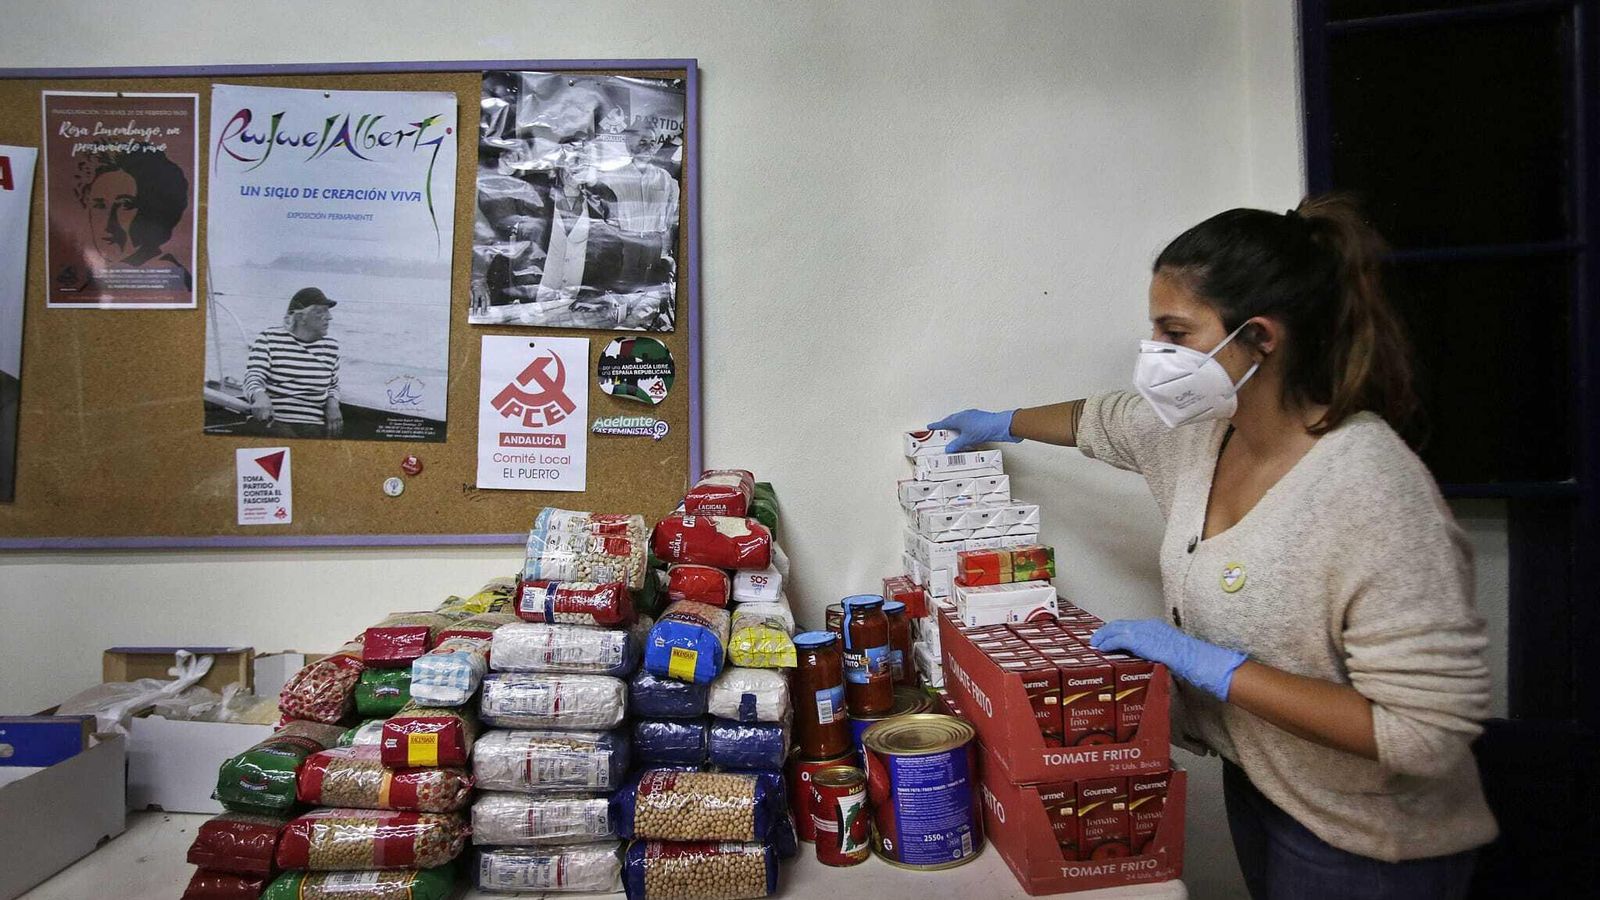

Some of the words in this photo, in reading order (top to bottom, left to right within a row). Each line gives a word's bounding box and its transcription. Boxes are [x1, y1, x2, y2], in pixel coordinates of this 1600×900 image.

[59, 121, 89, 138] Rosa
[166, 127, 182, 135] un
[71, 138, 140, 157] pensamiento
[142, 142, 167, 153] vivo
[240, 185, 261, 197] UN
[263, 186, 300, 199] SIGLO
[302, 187, 319, 199] DE
[322, 186, 388, 201] CREACIÓN
[390, 191, 422, 202] VIVA
[286, 211, 327, 220] EXPOSICIÓN
[328, 213, 374, 222] PERMANENTE
[500, 400, 566, 428] PCE
[593, 415, 654, 428] Adelante
[607, 427, 654, 435] FEMINISTAS
[503, 434, 562, 446] ANDALUCÍA
[492, 452, 536, 464] Comité
[540, 454, 571, 465] Local
[503, 467, 514, 479] EL
[518, 468, 560, 480] PUERTO
[242, 482, 274, 490] PARTIDO
[750, 575, 769, 585] SOS
[1068, 677, 1104, 687] Gourmet
[971, 681, 993, 718] FRITO
[1071, 708, 1105, 717] Tomate
[1042, 751, 1099, 766] TOMATE
[1103, 747, 1141, 761] FRITO
[1139, 760, 1161, 769] Bricks
[1083, 786, 1118, 797] Gourmet
[1134, 780, 1167, 791] Gourmet
[1086, 816, 1119, 827] Tomate
[1060, 863, 1117, 878] TOMATE
[1120, 858, 1158, 873] FRITO
